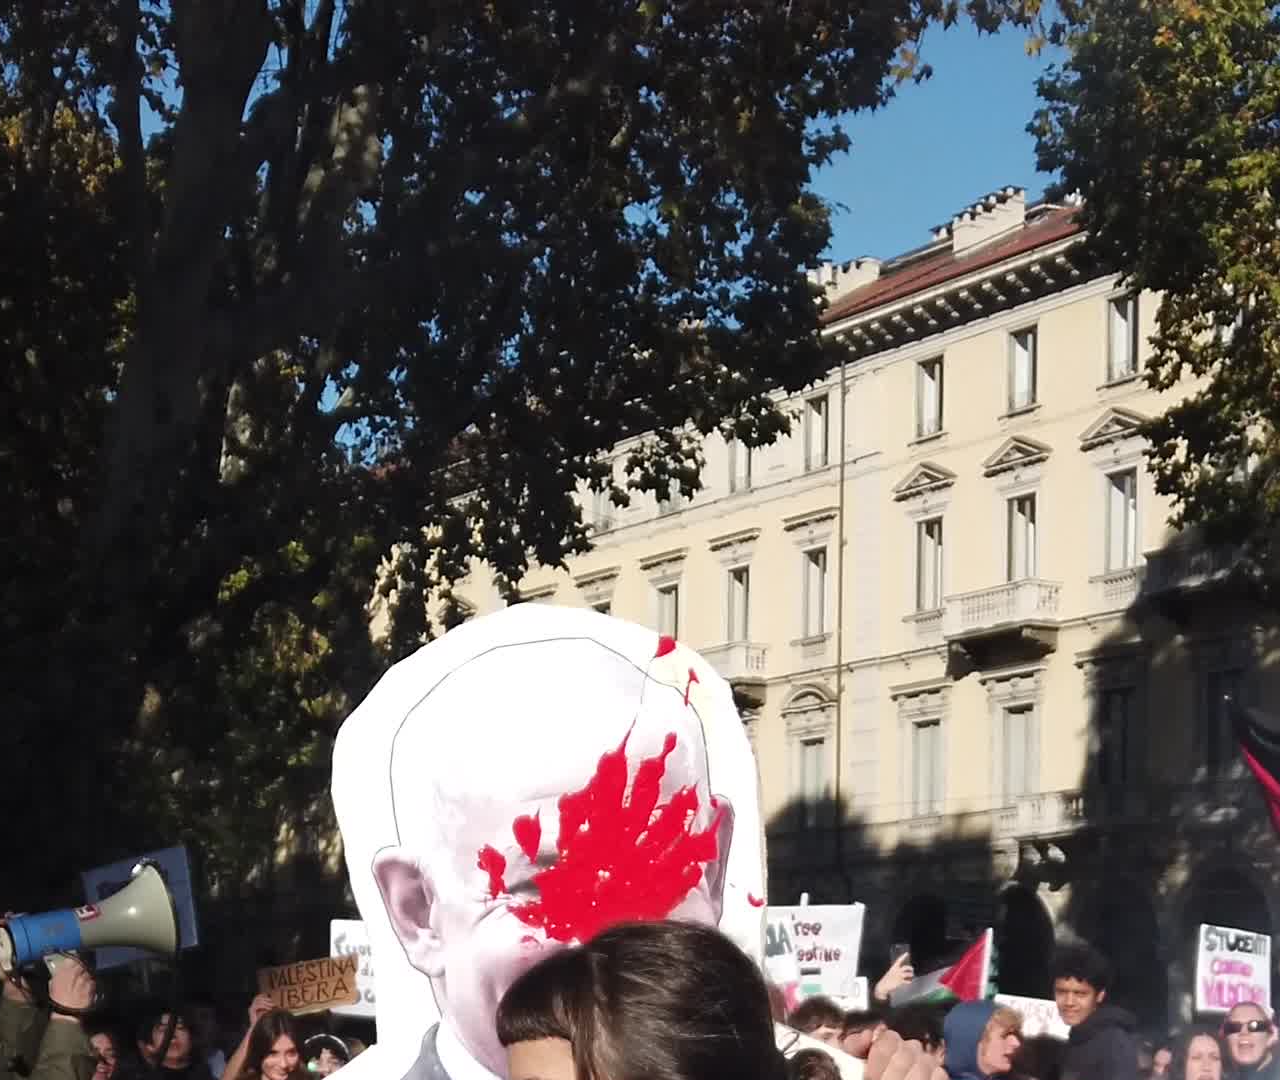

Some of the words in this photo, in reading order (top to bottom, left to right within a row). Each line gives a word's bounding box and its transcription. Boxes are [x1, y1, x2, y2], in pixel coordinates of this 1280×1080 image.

[790, 911, 822, 937] ree
[269, 956, 359, 990] PALESTINA
[270, 977, 350, 1010] IBERA
